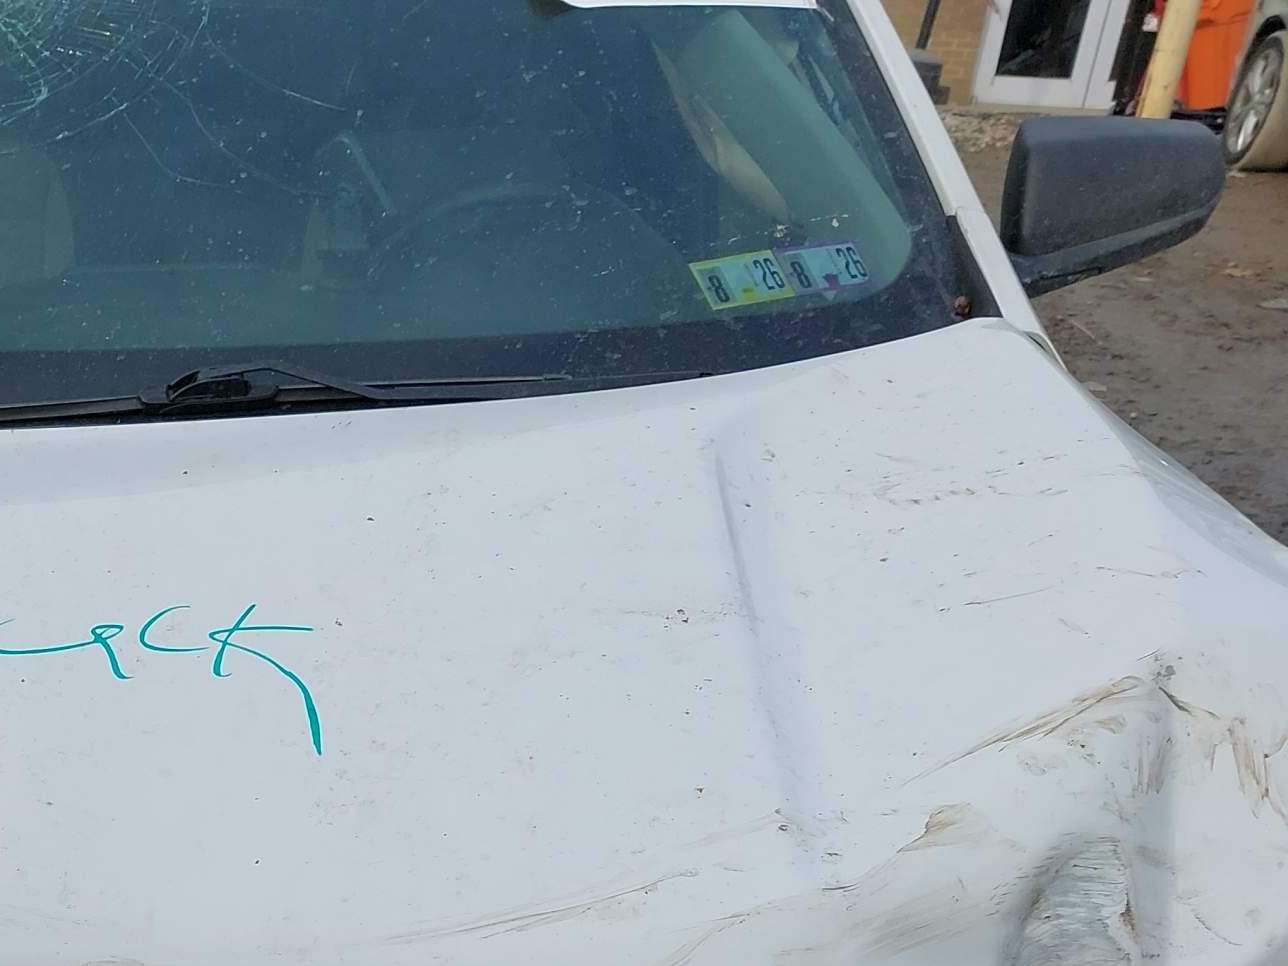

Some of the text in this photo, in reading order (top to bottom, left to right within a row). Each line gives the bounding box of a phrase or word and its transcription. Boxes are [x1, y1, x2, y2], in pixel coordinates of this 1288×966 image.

[707, 257, 785, 304] 8 26
[790, 246, 868, 289] 8 26
